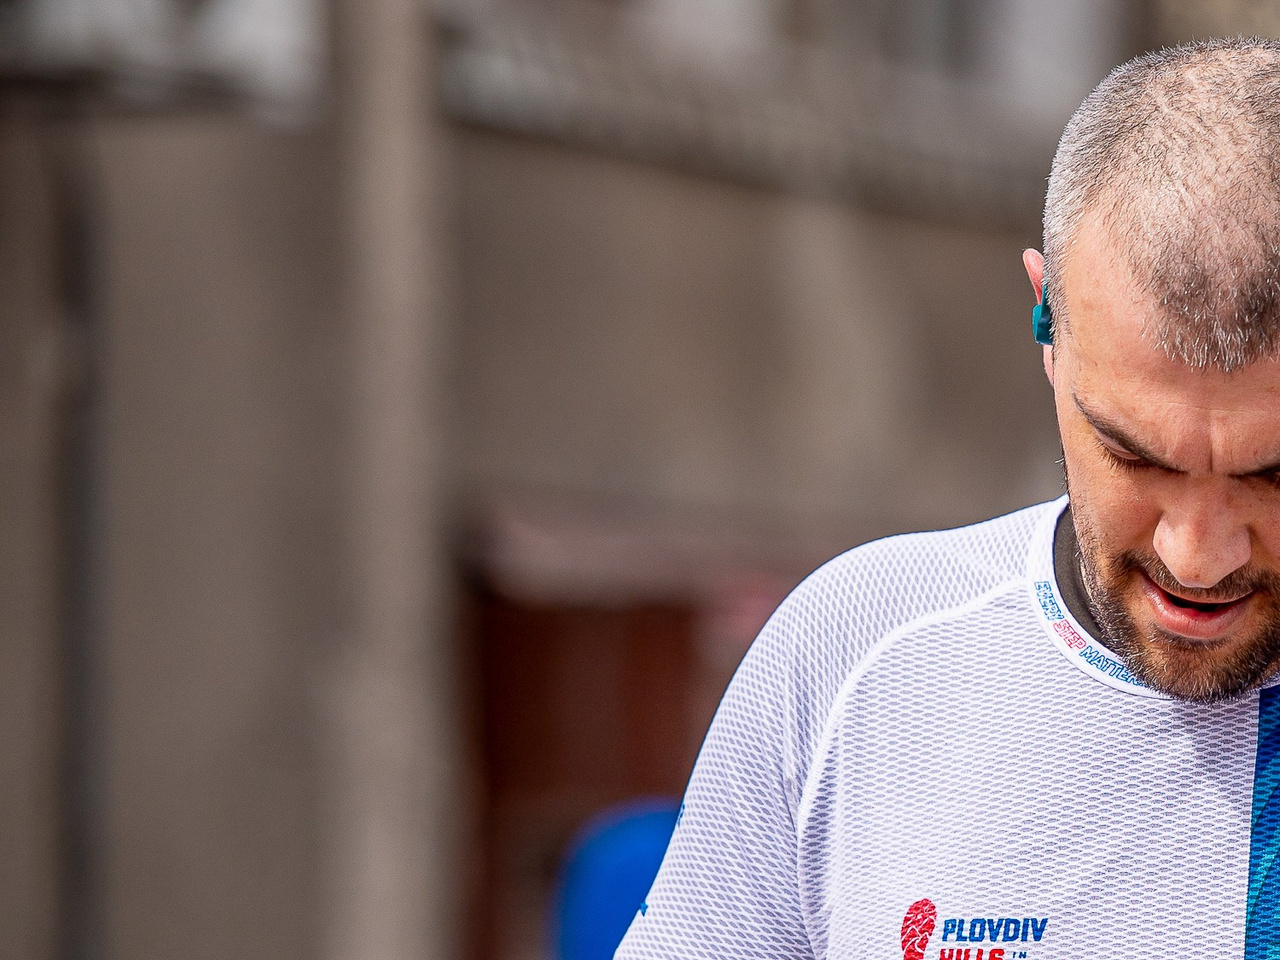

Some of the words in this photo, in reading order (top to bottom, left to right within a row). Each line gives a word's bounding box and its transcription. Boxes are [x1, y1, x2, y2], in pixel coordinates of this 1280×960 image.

[1053, 619, 1087, 649] STEP
[1079, 645, 1149, 687] MATTE
[942, 917, 1048, 942] PLOVDIV
[1012, 951, 1027, 959] IN
